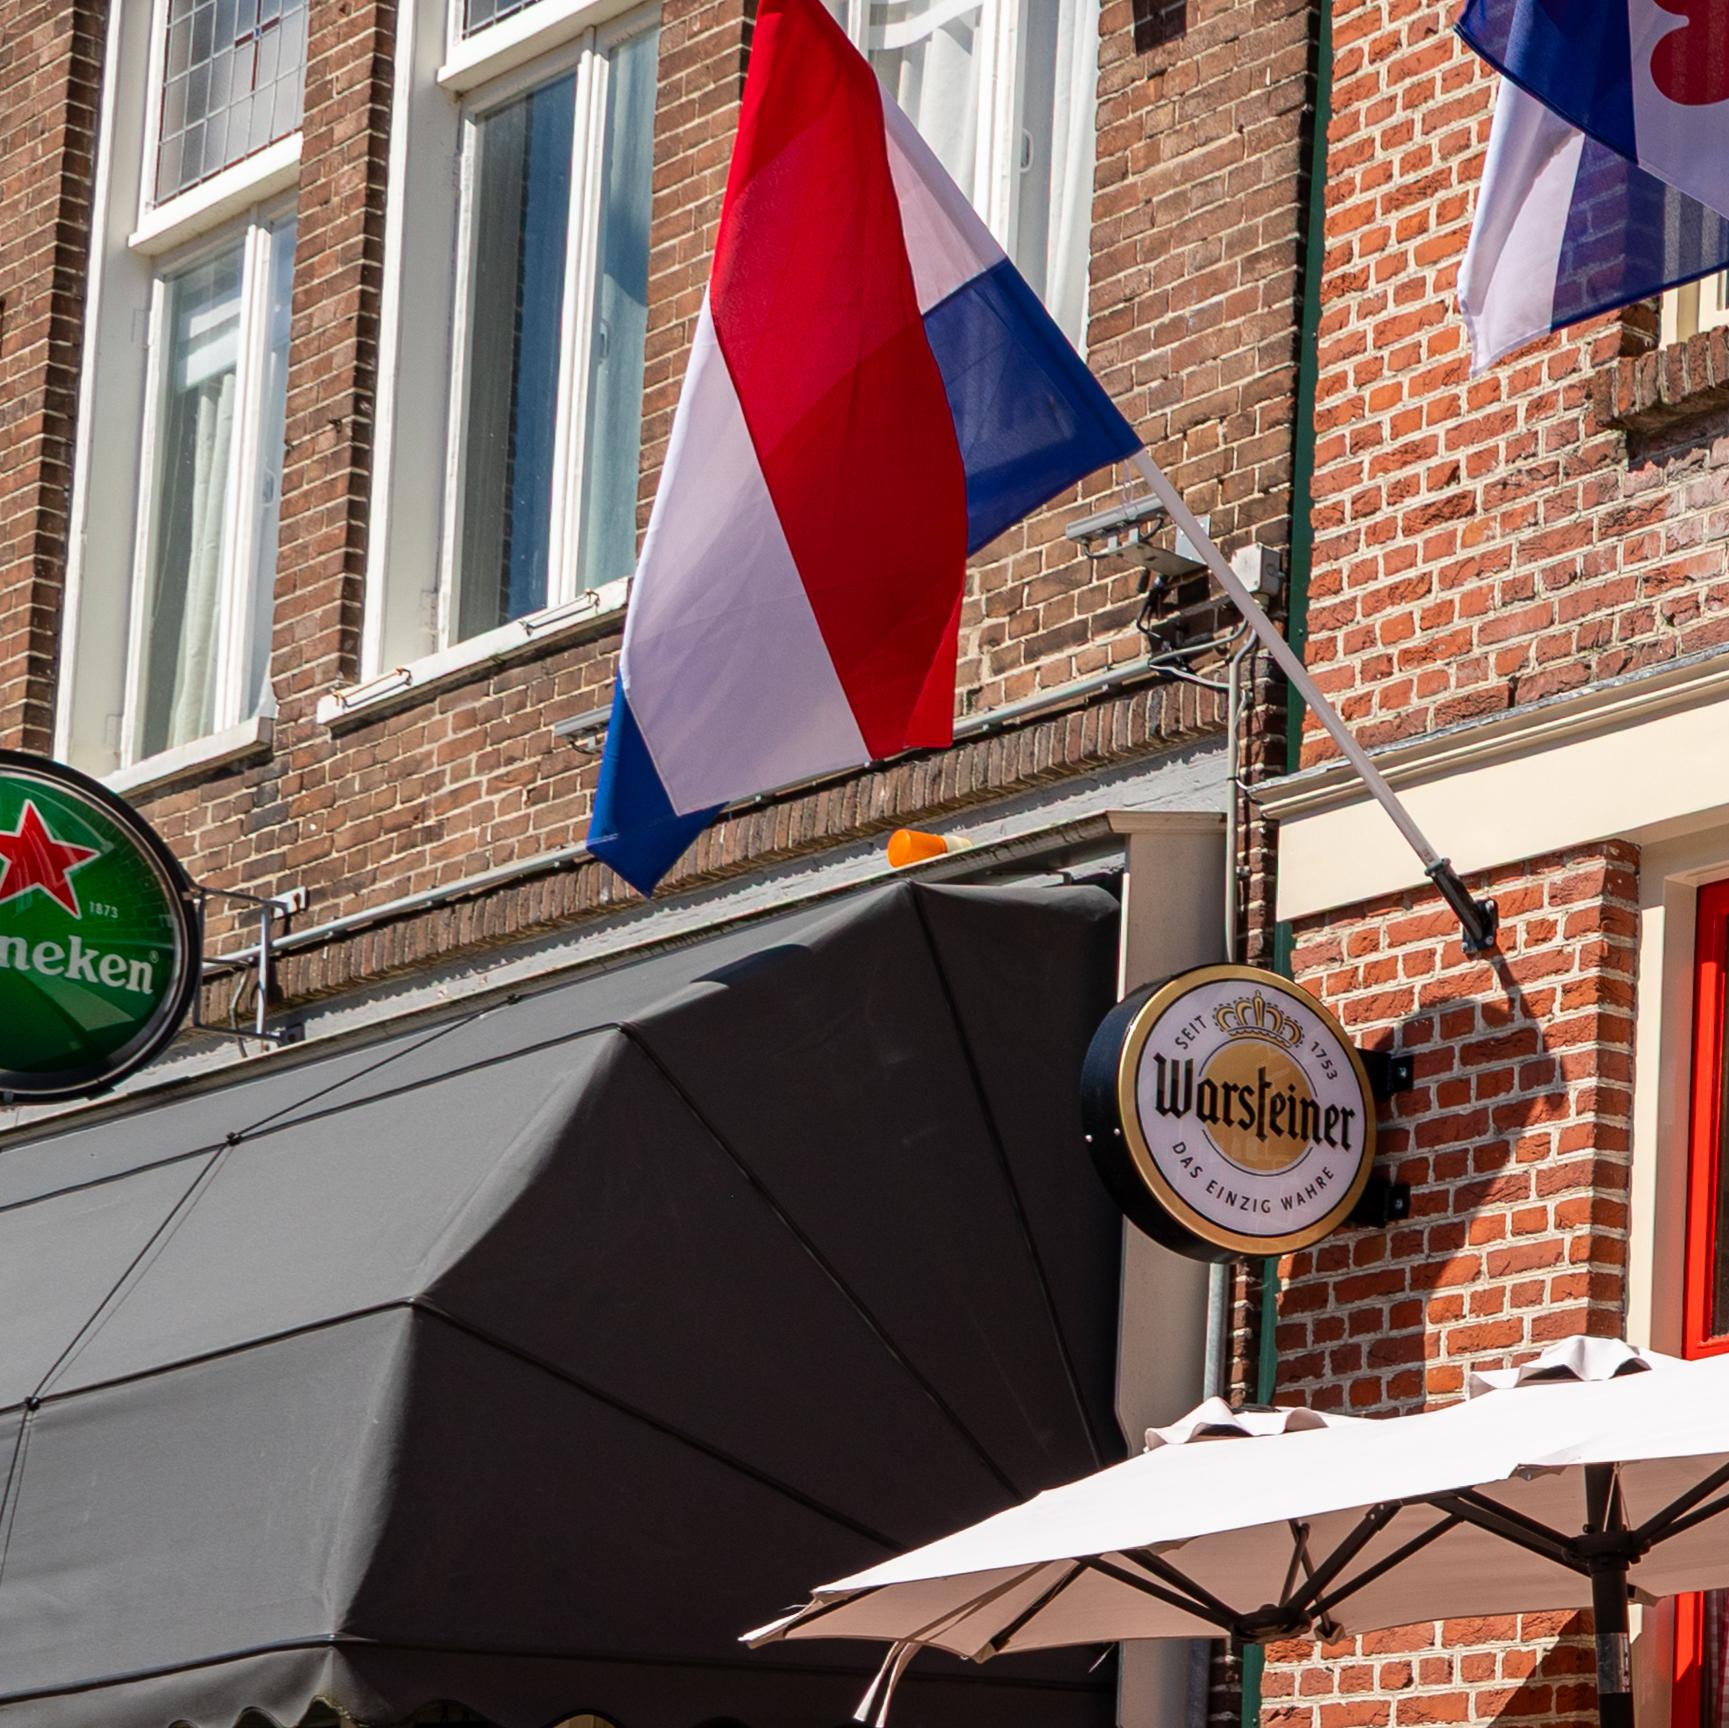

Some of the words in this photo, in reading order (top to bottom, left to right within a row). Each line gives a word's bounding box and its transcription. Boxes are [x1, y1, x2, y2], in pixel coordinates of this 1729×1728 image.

[90, 901, 118, 918] 1873
[1175, 1015, 1207, 1050] SEIT
[1310, 1041, 1338, 1080] 1753
[1152, 1052, 1355, 1152] Warsteiner
[1172, 1142, 1203, 1178] DAS
[1206, 1180, 1271, 1213] EINZIG
[1281, 1167, 1334, 1210] WAHRE
